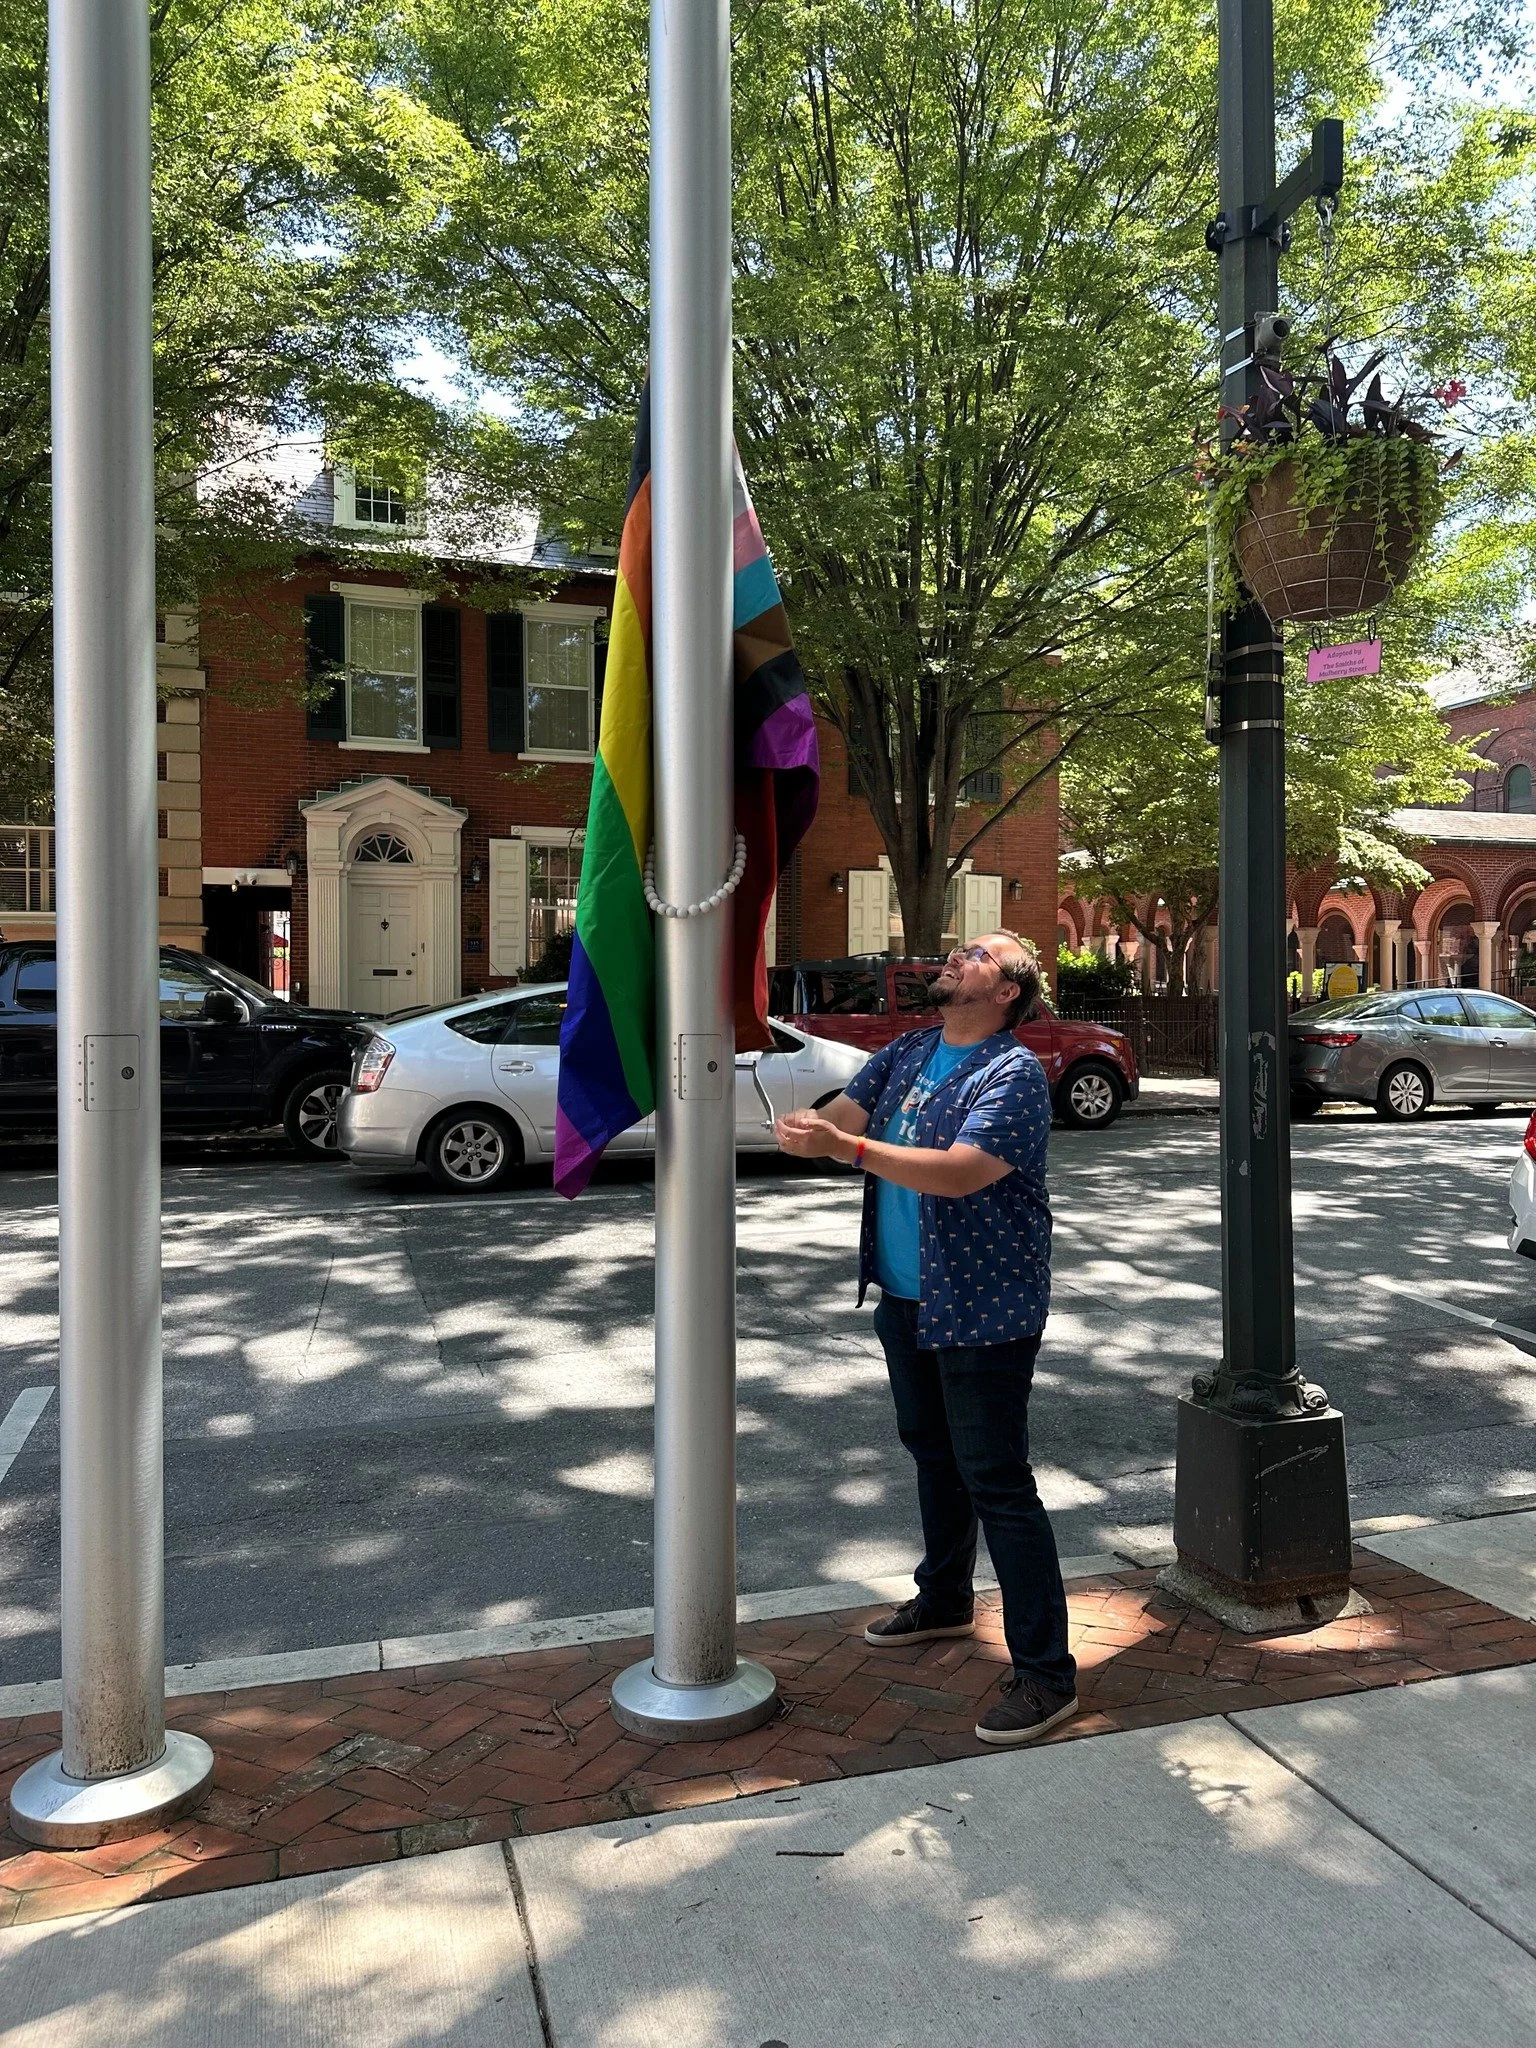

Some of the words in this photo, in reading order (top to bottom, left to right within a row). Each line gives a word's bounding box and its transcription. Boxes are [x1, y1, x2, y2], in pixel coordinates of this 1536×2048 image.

[1327, 649, 1353, 659] Adopted
[1335, 660, 1357, 668] Smiths
[1319, 669, 1347, 677] Mulberry
[1348, 665, 1368, 673] Street
